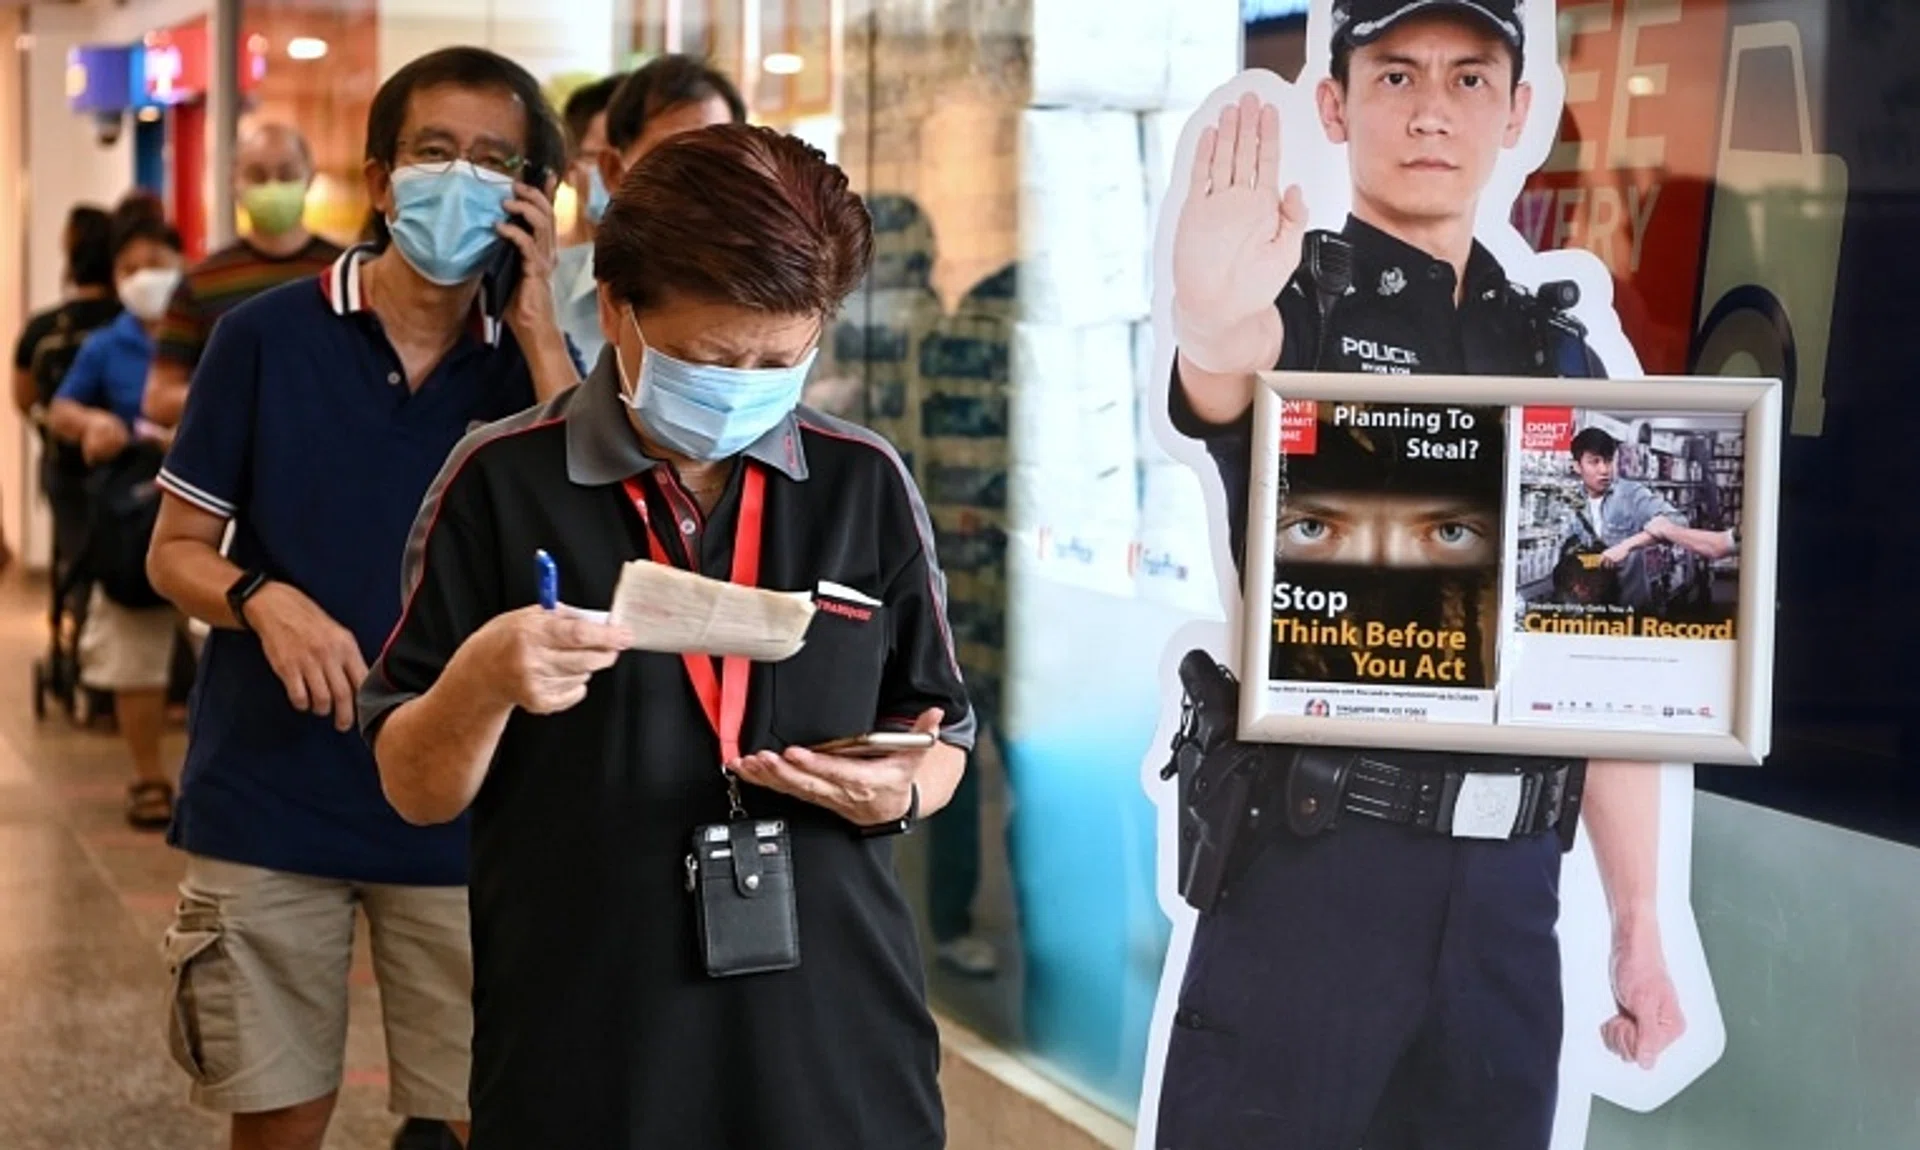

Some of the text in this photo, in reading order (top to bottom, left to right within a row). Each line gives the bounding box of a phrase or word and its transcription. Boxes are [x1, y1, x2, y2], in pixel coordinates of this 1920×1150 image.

[1341, 335, 1420, 365] POLICE
[1333, 405, 1475, 434] Planning To
[1406, 437, 1480, 459] Steal?
[1273, 582, 1348, 618] Stop
[1273, 618, 1466, 649] Think Before
[1524, 612, 1733, 640] Criminal Record
[1351, 651, 1466, 681] You Act
